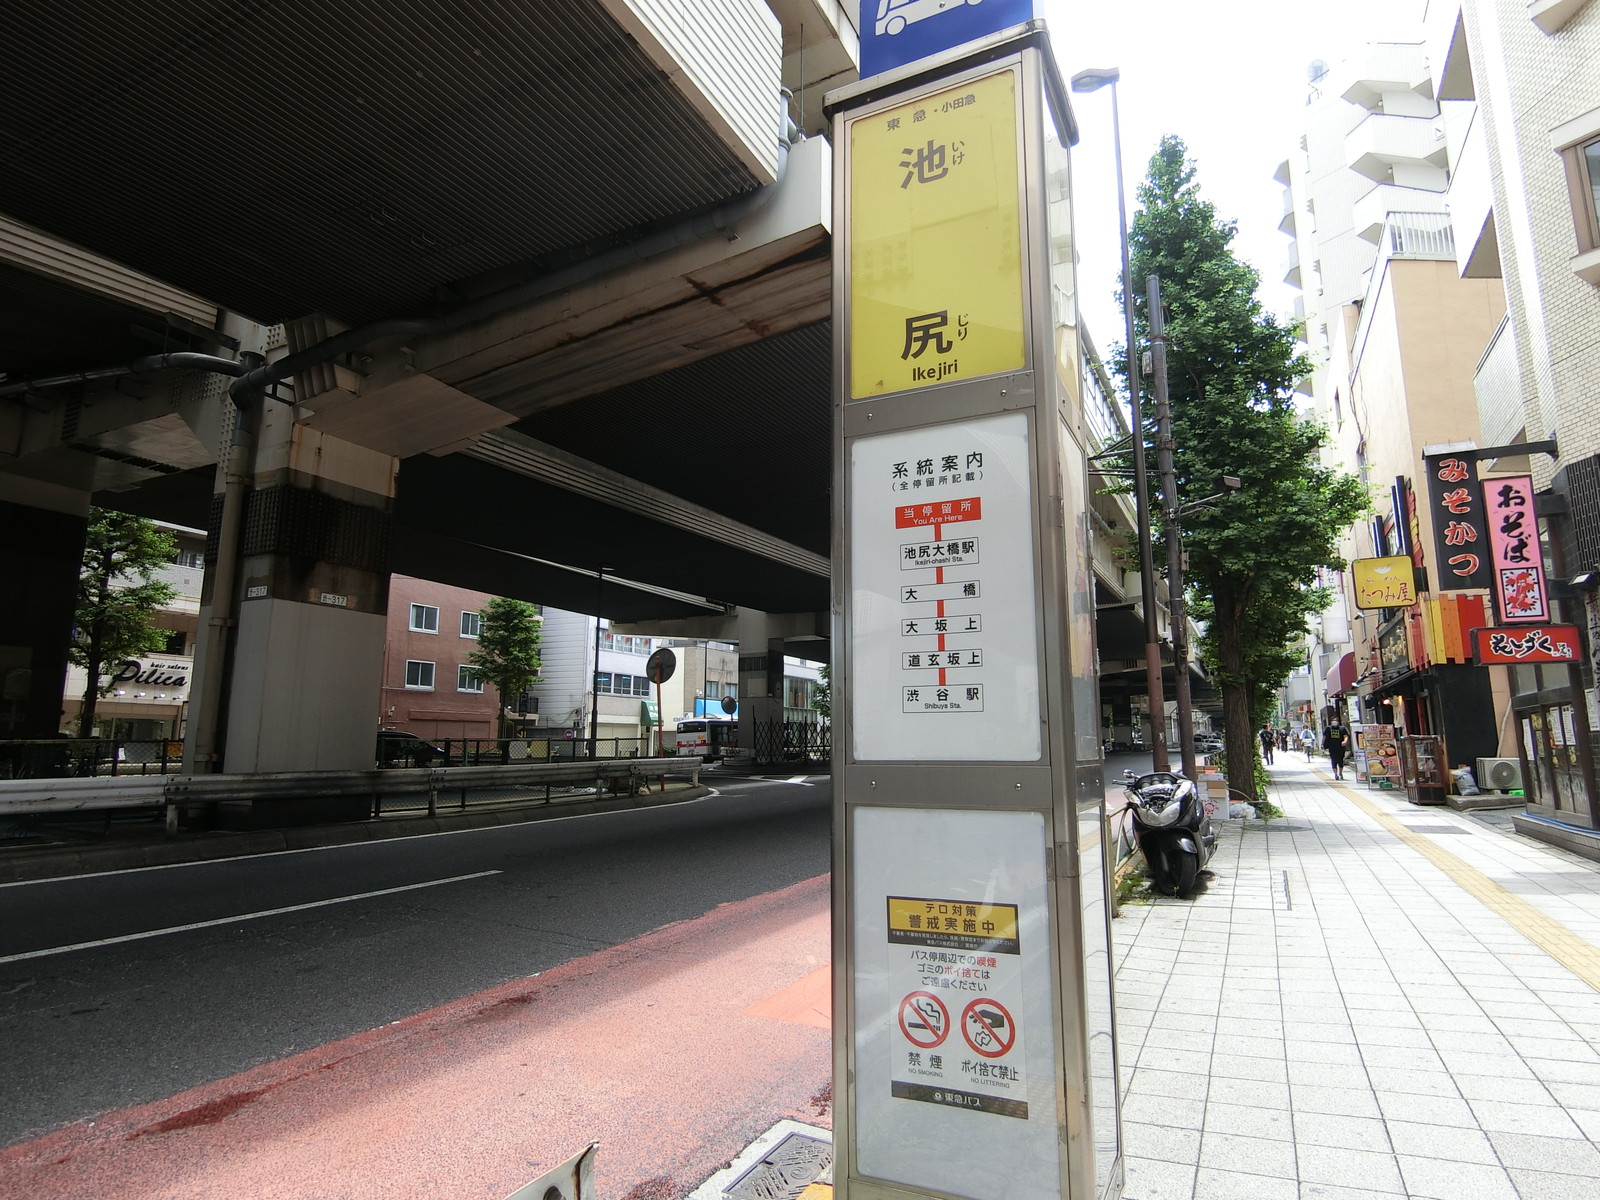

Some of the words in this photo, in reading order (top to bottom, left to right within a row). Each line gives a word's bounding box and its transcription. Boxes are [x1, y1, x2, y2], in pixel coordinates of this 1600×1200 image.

[951, 140, 966, 166] いけ
[898, 139, 949, 190] 池
[900, 310, 953, 361] 尻
[957, 313, 969, 341] じり
[912, 360, 958, 382] Ikejiri
[892, 451, 983, 479] 系統案内
[903, 500, 972, 519] 当停留所
[1438, 458, 1480, 576] みそかつ
[913, 517, 928, 526] You
[929, 515, 943, 524] Are
[944, 513, 963, 522] Here
[1497, 484, 1532, 563] おそば
[904, 540, 975, 560] 池尻大橋駅
[914, 556, 951, 566] Ikejiri-ohashi
[951, 555, 964, 564] Sta.
[1361, 582, 1413, 605] たつみ屋
[905, 617, 978, 634] 大坂上
[908, 651, 980, 667] 道玄坂上
[105, 660, 188, 692] Pilica
[906, 687, 979, 702] 渋谷駅
[924, 702, 949, 710] Shibuya
[925, 903, 977, 917] テロ対策
[908, 914, 995, 934] 警戒実施中
[910, 950, 997, 968] バス停周辺での喫煙
[917, 962, 990, 979] ゴミのポイ捨ては
[921, 976, 987, 992] ご遠慮ください
[908, 1051, 943, 1069] 禁煙
[917, 1069, 943, 1078] SMOKING
[961, 1060, 1020, 1081] ポイ捨て禁止
[980, 1079, 1010, 1089] LITTERING
[944, 1092, 982, 1107] 東急バス
